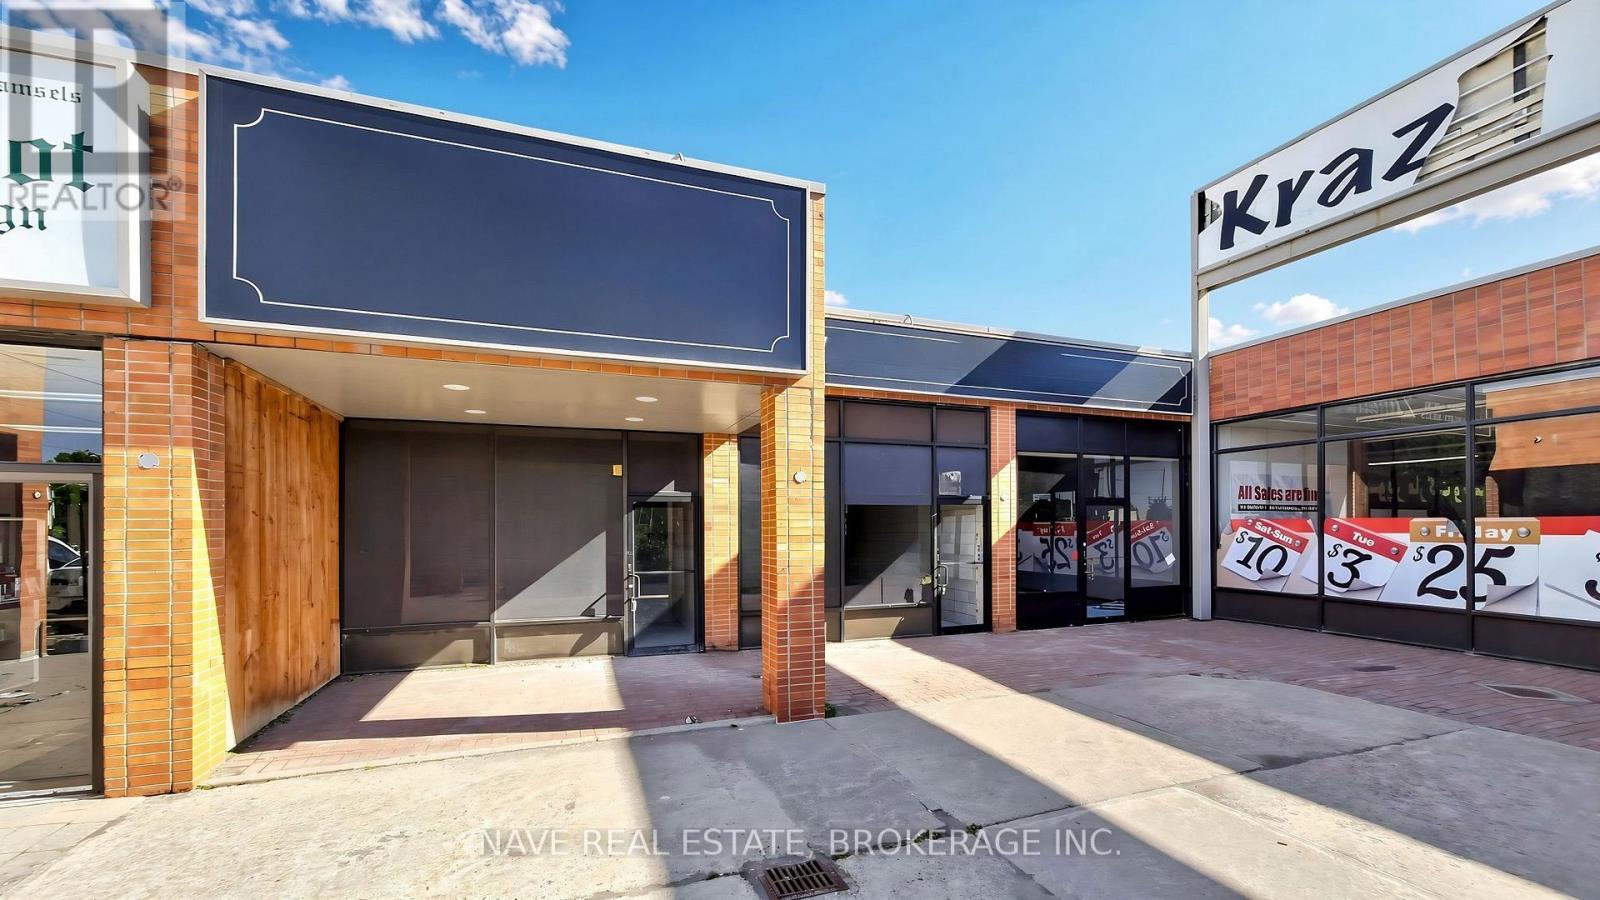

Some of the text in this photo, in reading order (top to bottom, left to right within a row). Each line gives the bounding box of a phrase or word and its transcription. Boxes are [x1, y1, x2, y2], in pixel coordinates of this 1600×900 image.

[1219, 102, 1455, 250] Kraz
[1238, 486, 1252, 500] All
[1285, 489, 1302, 501] are
[1254, 521, 1293, 545] Sat-Sun
[1352, 532, 1375, 547] Tue
